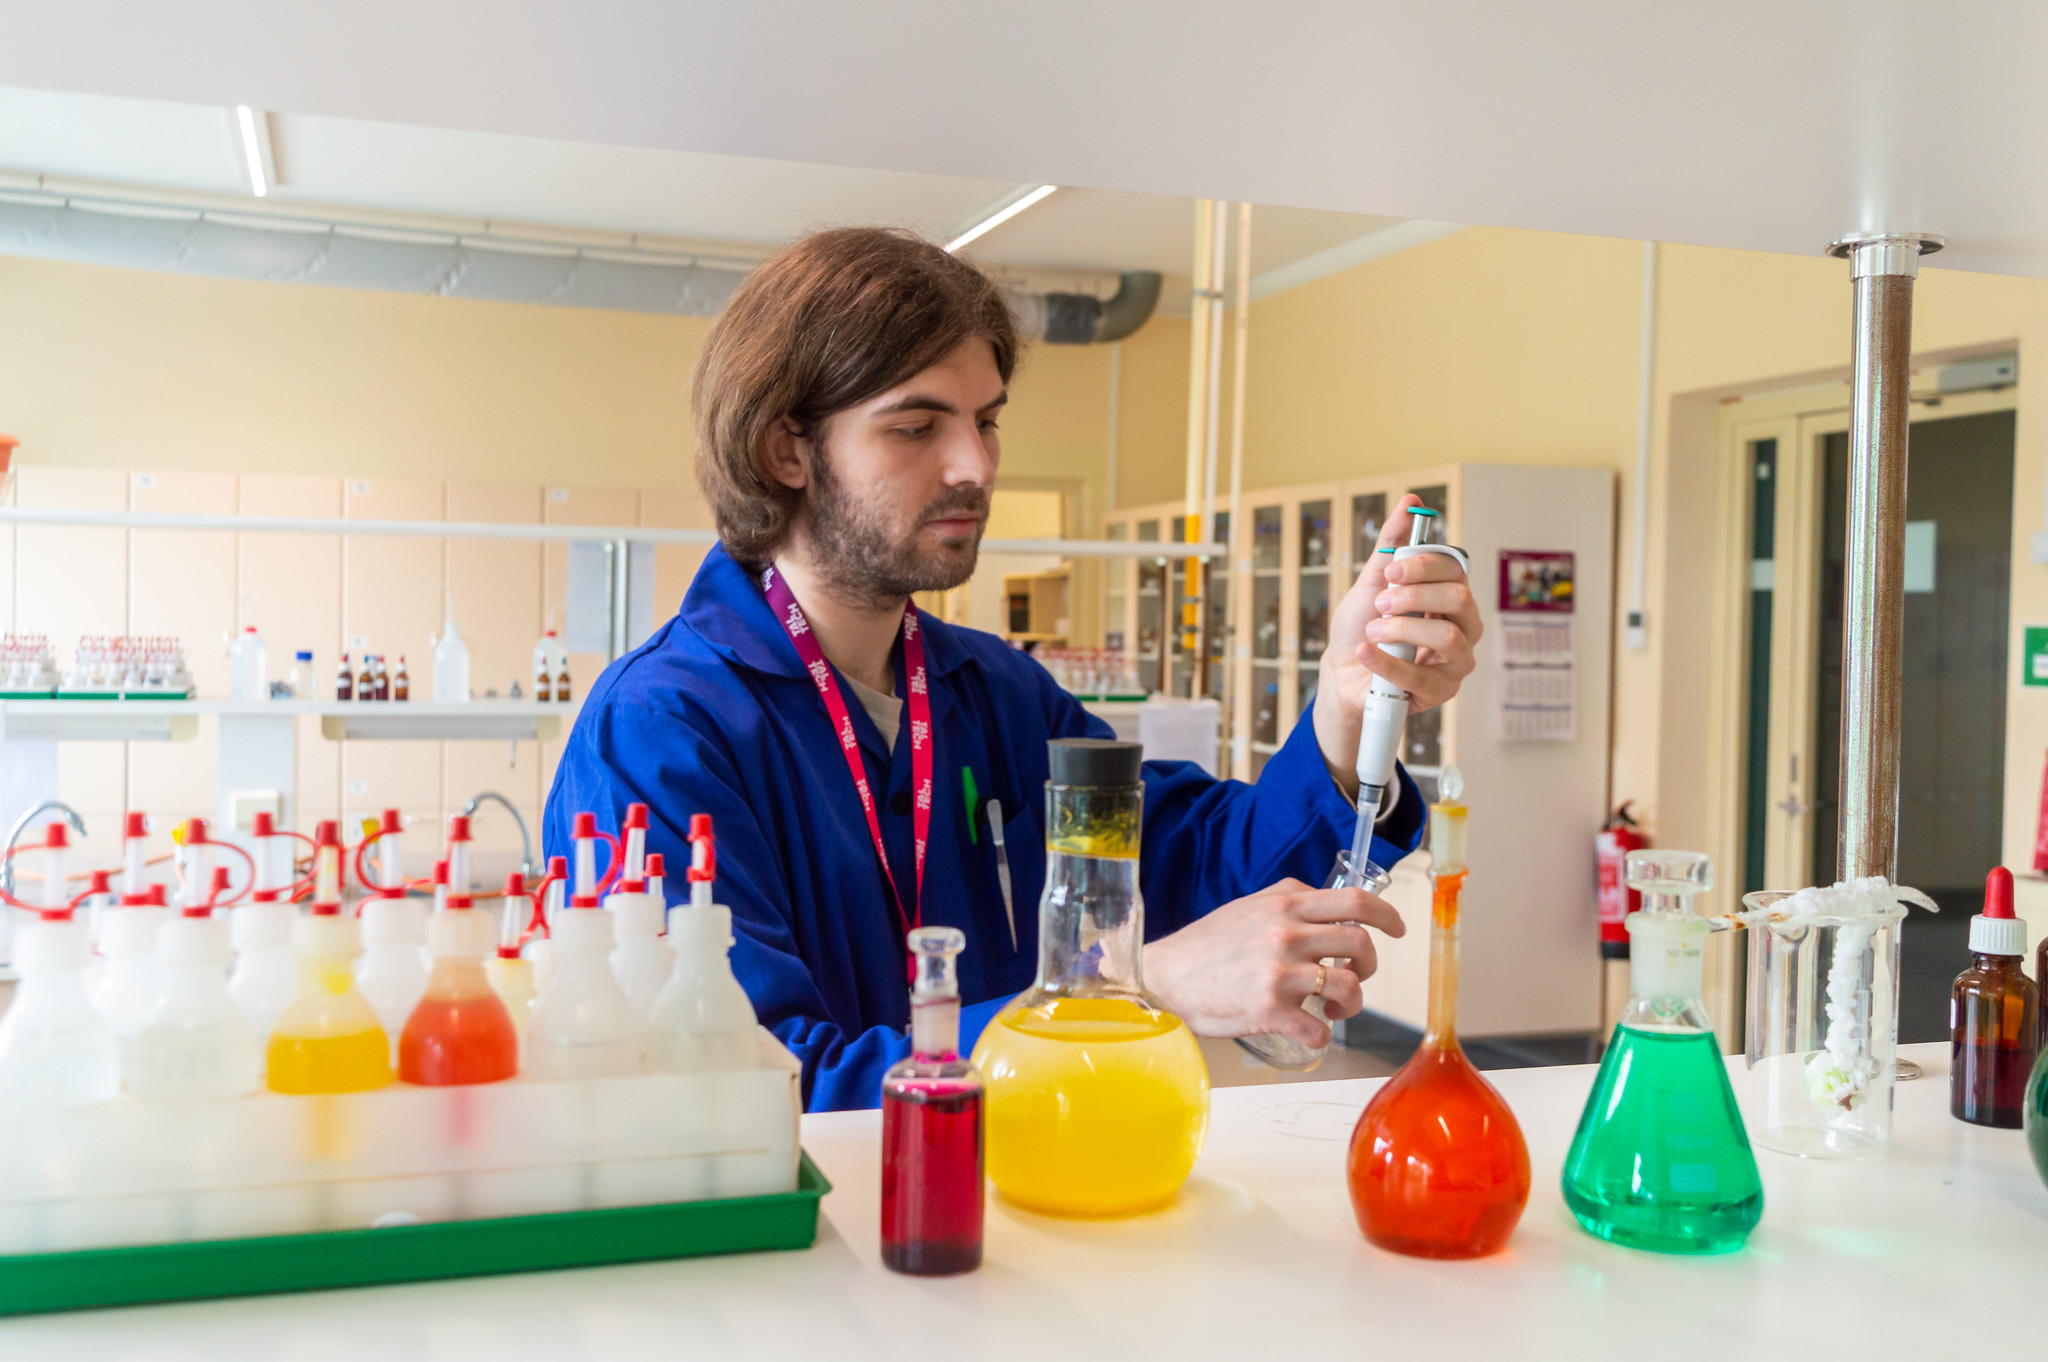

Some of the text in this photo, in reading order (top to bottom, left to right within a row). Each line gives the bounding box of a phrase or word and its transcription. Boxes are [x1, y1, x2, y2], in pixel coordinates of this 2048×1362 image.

[786, 615, 800, 637] TAL
[787, 603, 809, 634] TECH
[808, 660, 829, 692] TECH
[912, 720, 922, 750] TECH
